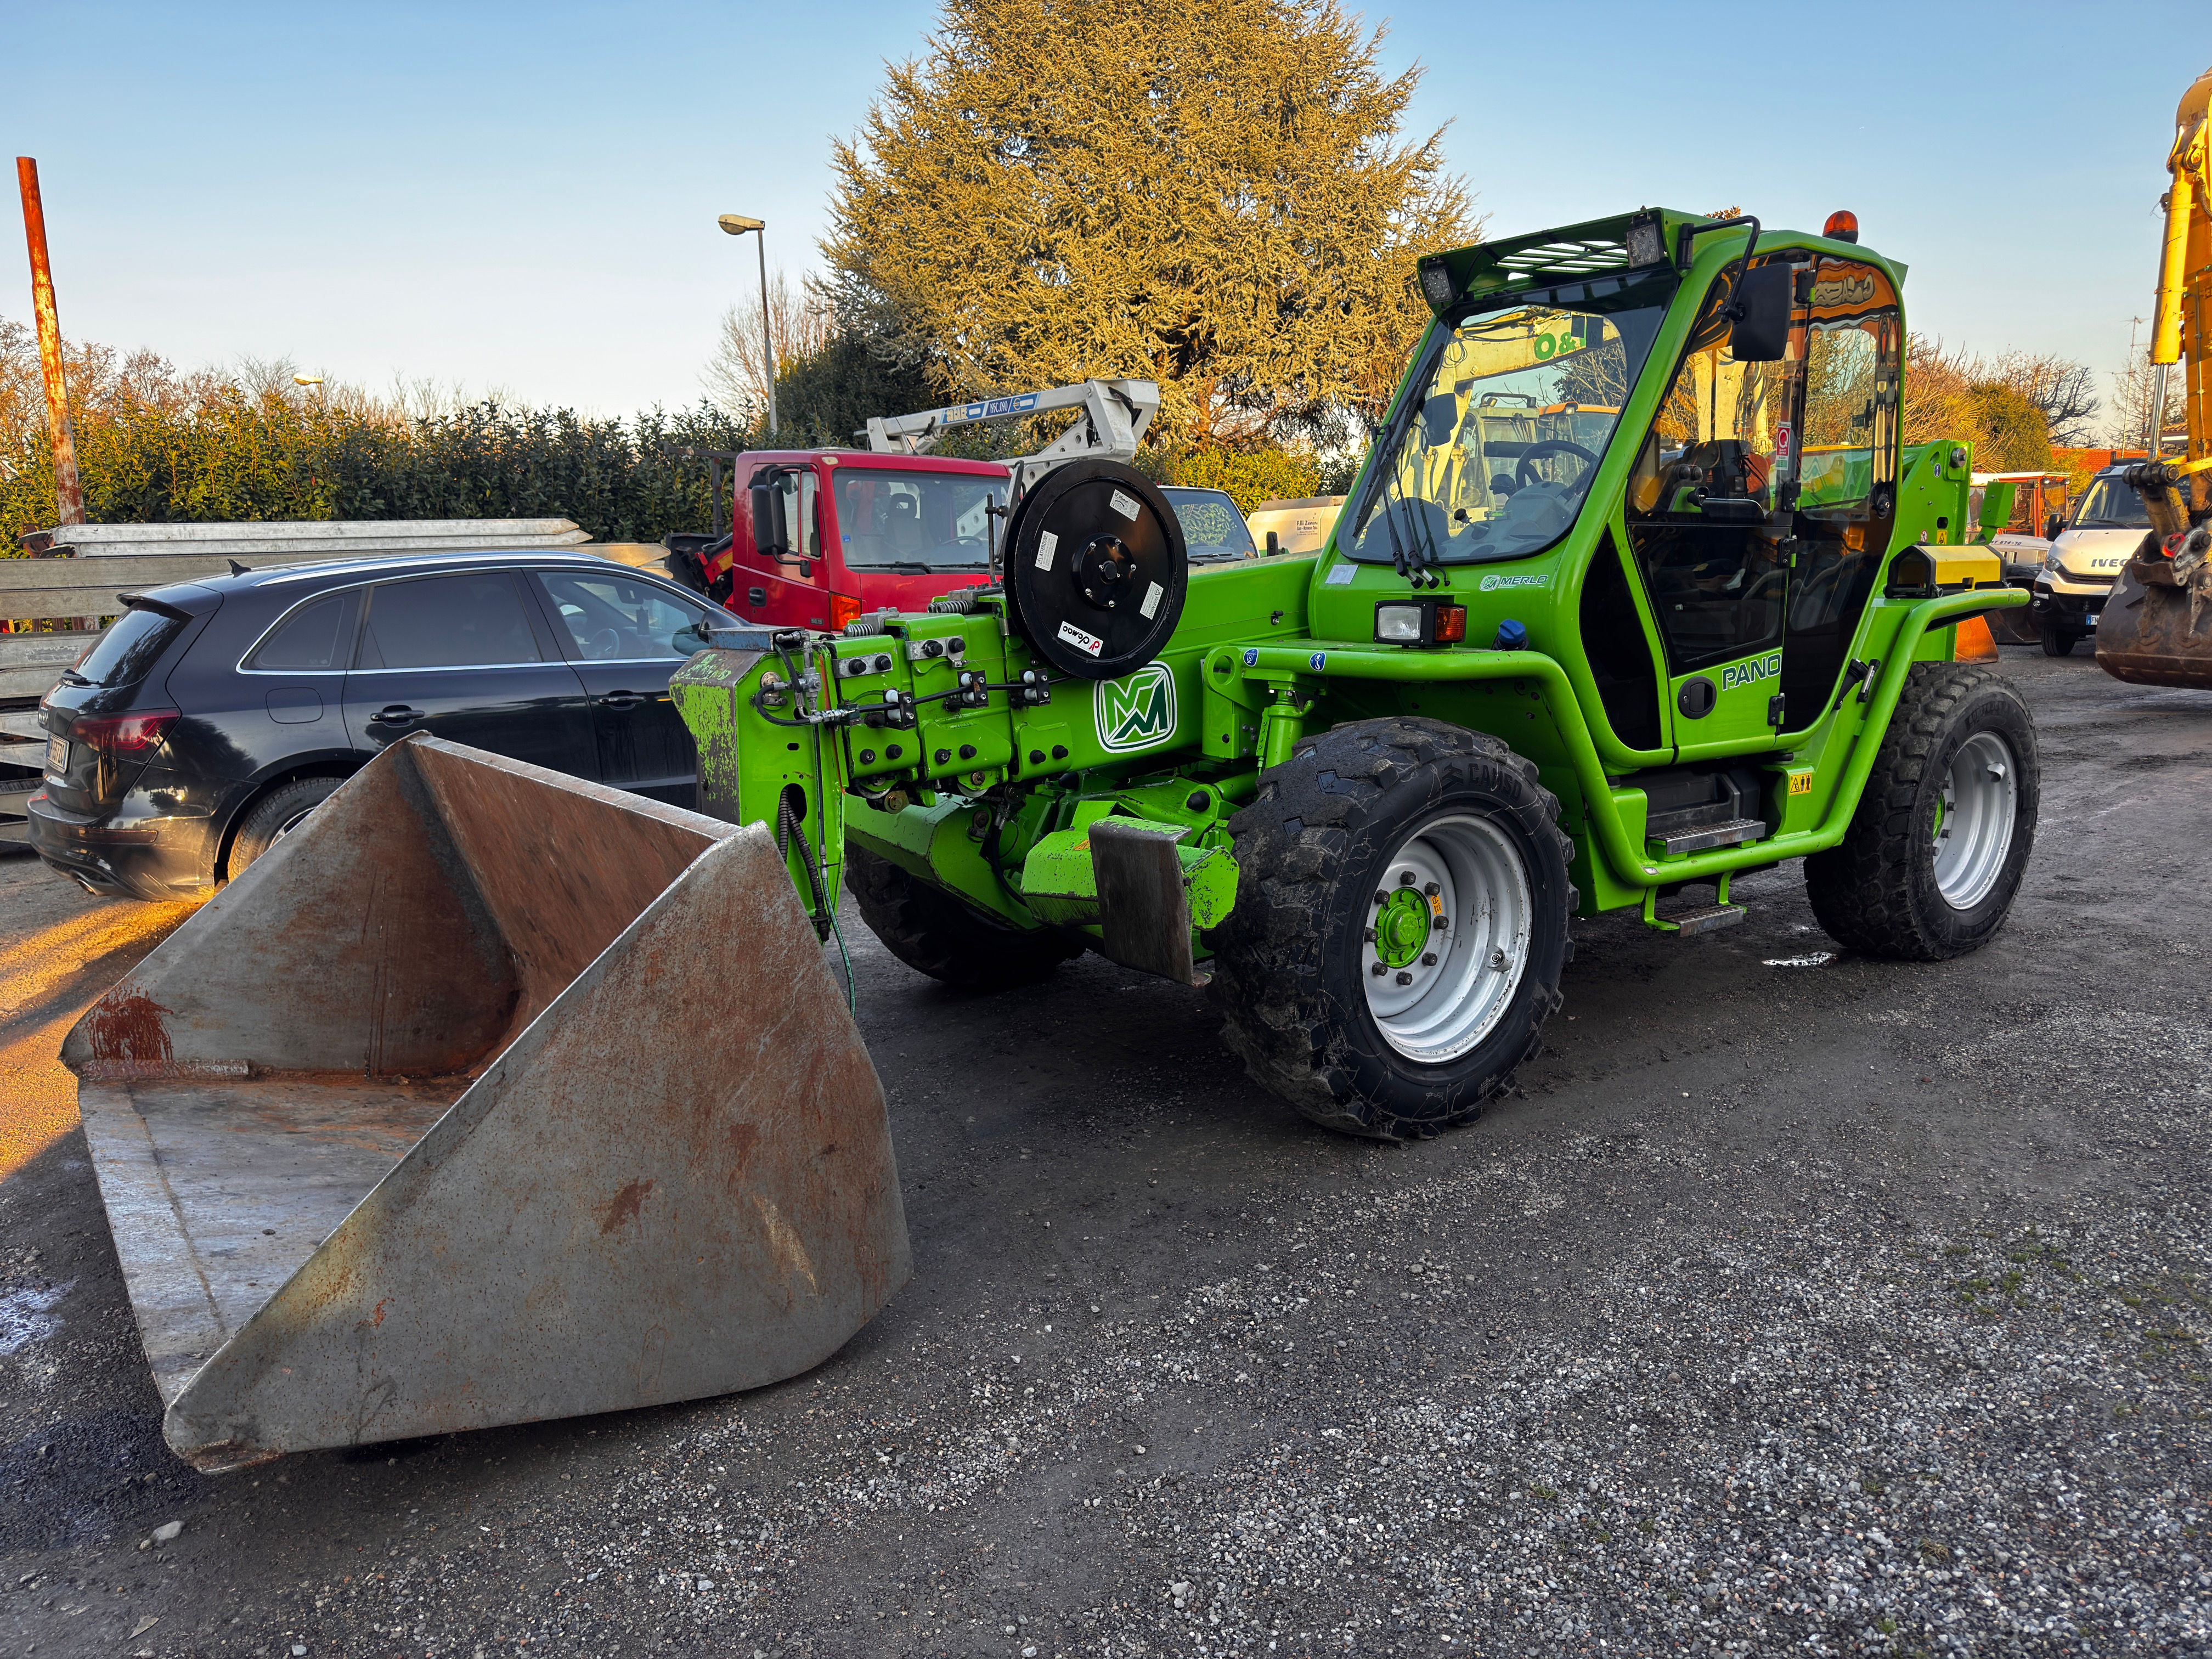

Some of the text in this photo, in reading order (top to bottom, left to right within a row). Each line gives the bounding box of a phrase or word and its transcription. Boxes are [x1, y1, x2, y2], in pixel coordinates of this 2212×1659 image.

[1499, 575, 1548, 585] MERLO
[1149, 596, 1159, 617] WARNING
[1722, 653, 1782, 691] PANO
[1468, 763, 1522, 803] CAMSO
